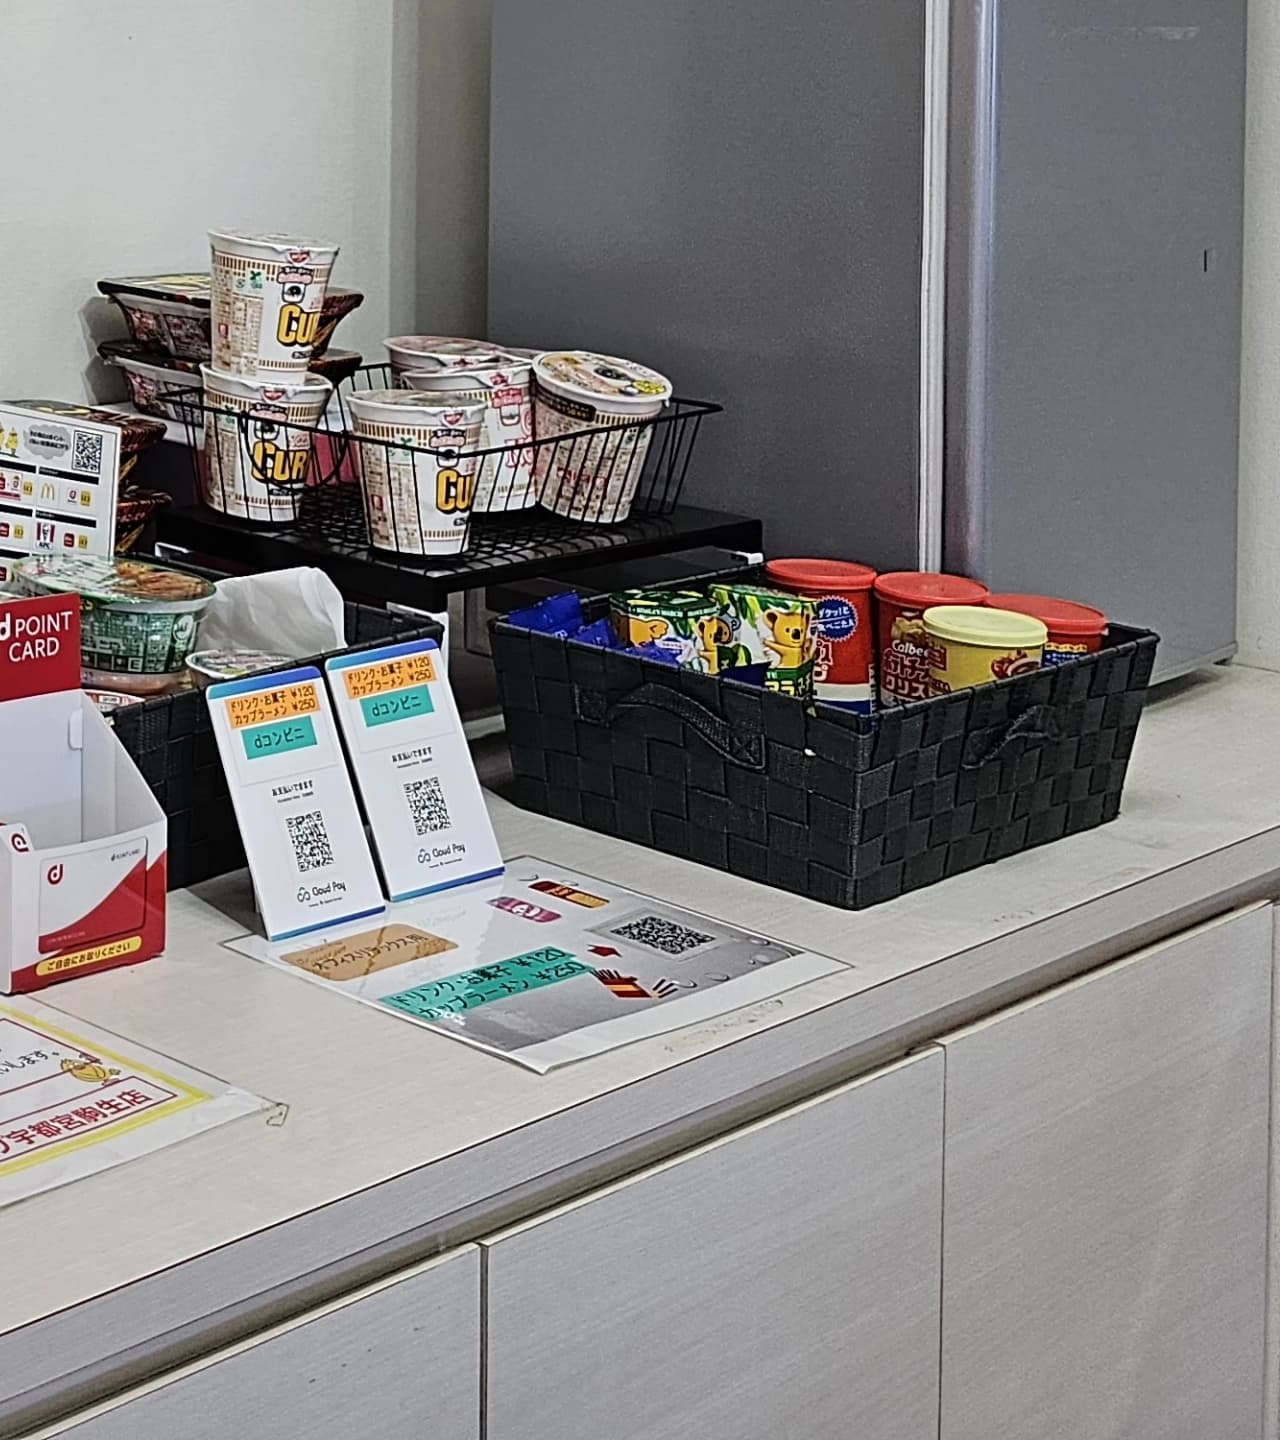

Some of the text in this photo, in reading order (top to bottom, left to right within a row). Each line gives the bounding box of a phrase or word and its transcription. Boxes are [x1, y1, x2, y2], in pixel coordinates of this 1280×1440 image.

[15, 610, 74, 638] POINT
[8, 636, 61, 663] CARD
[352, 669, 432, 696] カップラーメン ¥250
[234, 698, 316, 726] カップラーメン ¥250
[371, 695, 422, 718] dコンビニ
[254, 727, 305, 749] dコンビニ
[418, 979, 529, 1020] カップラーメン
